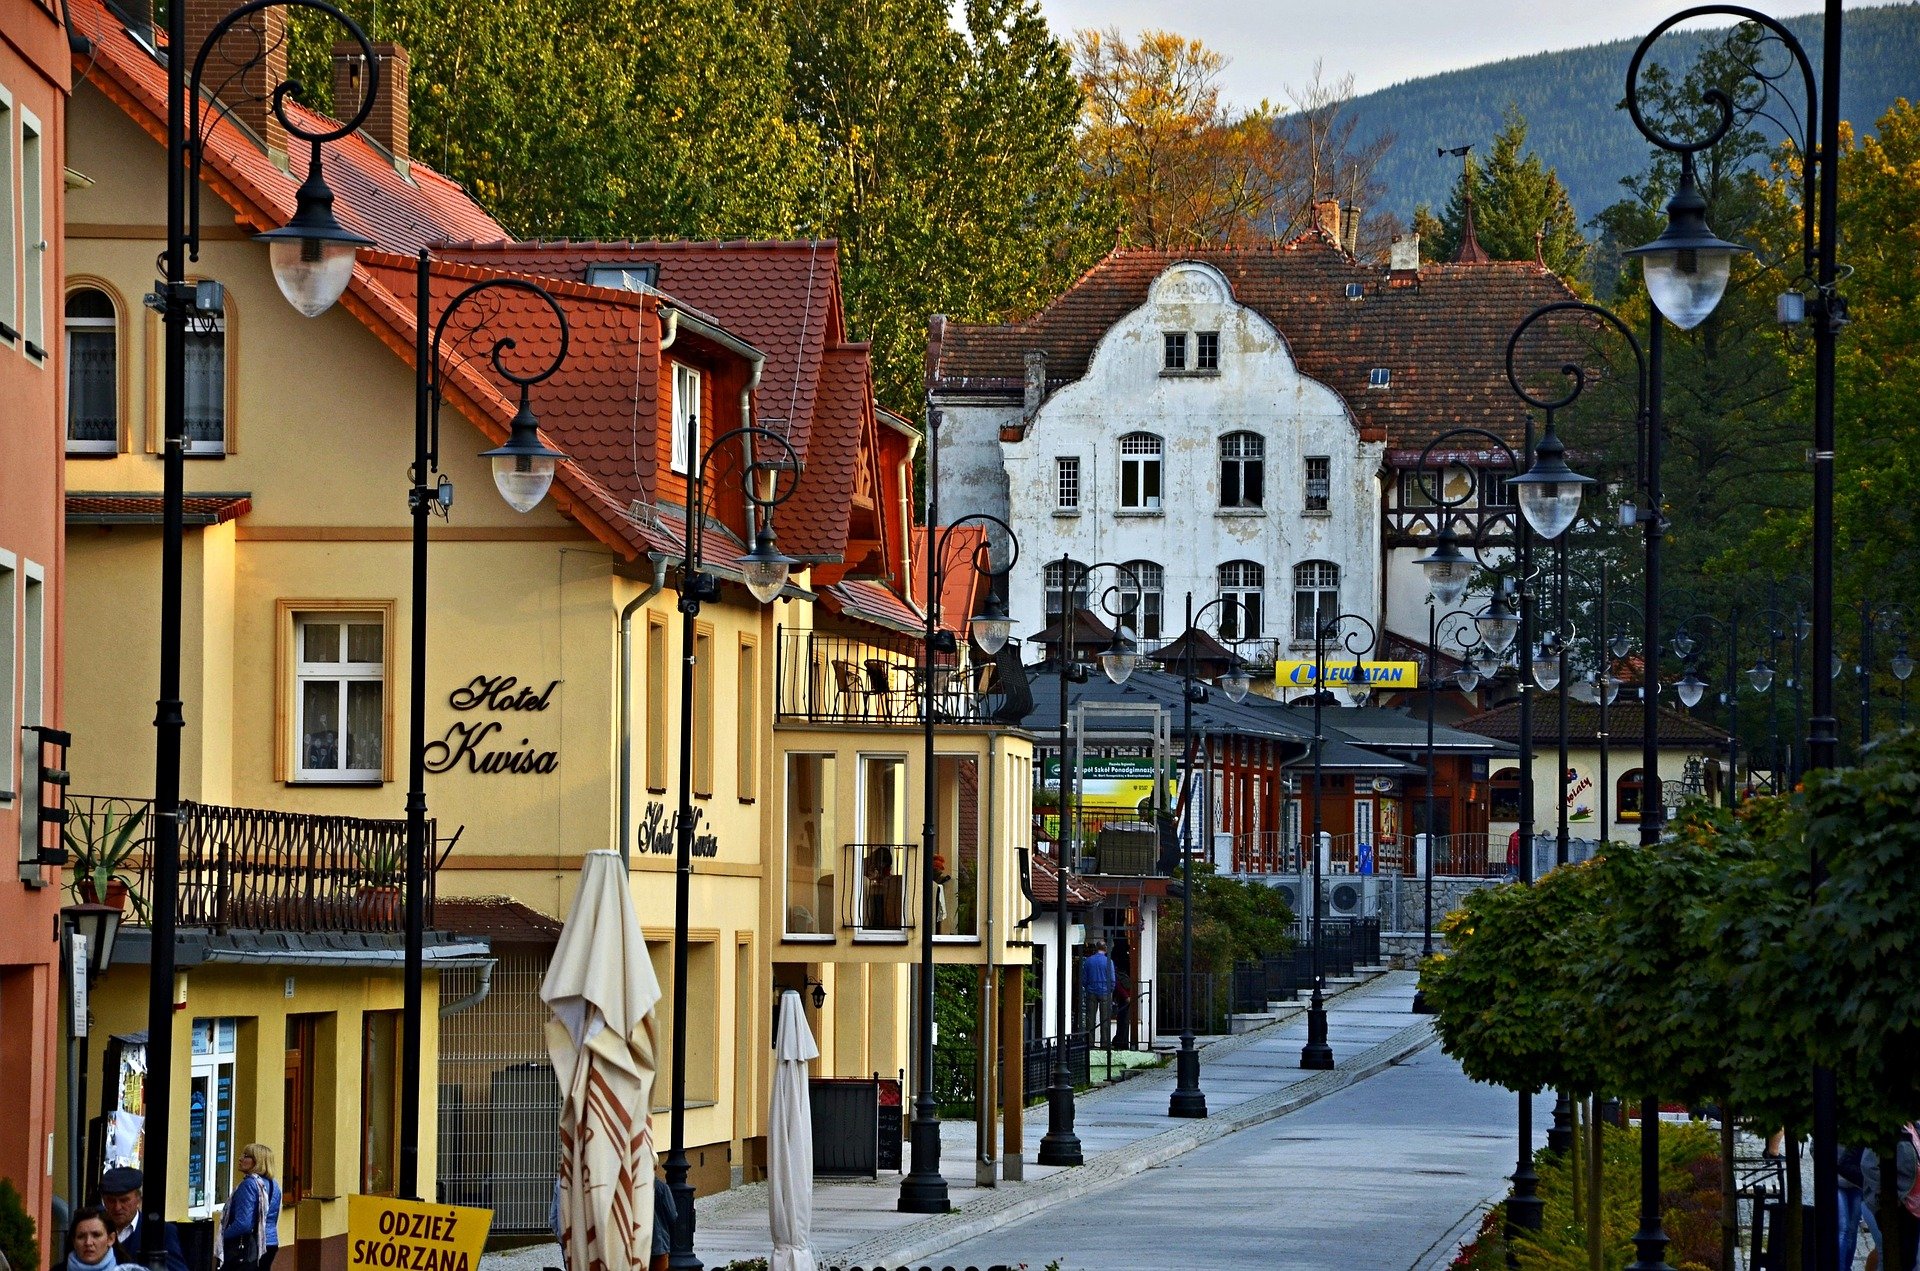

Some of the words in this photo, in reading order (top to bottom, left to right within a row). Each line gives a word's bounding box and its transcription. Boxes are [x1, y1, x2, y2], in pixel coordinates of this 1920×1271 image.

[1324, 668, 1403, 681] LEWATAN
[450, 675, 558, 711] Hotel
[424, 721, 559, 774] Kwisa
[1556, 777, 1592, 811] wiaty
[379, 1210, 458, 1242] ODZIEŻ
[353, 1236, 469, 1271] SKÓRZANA
